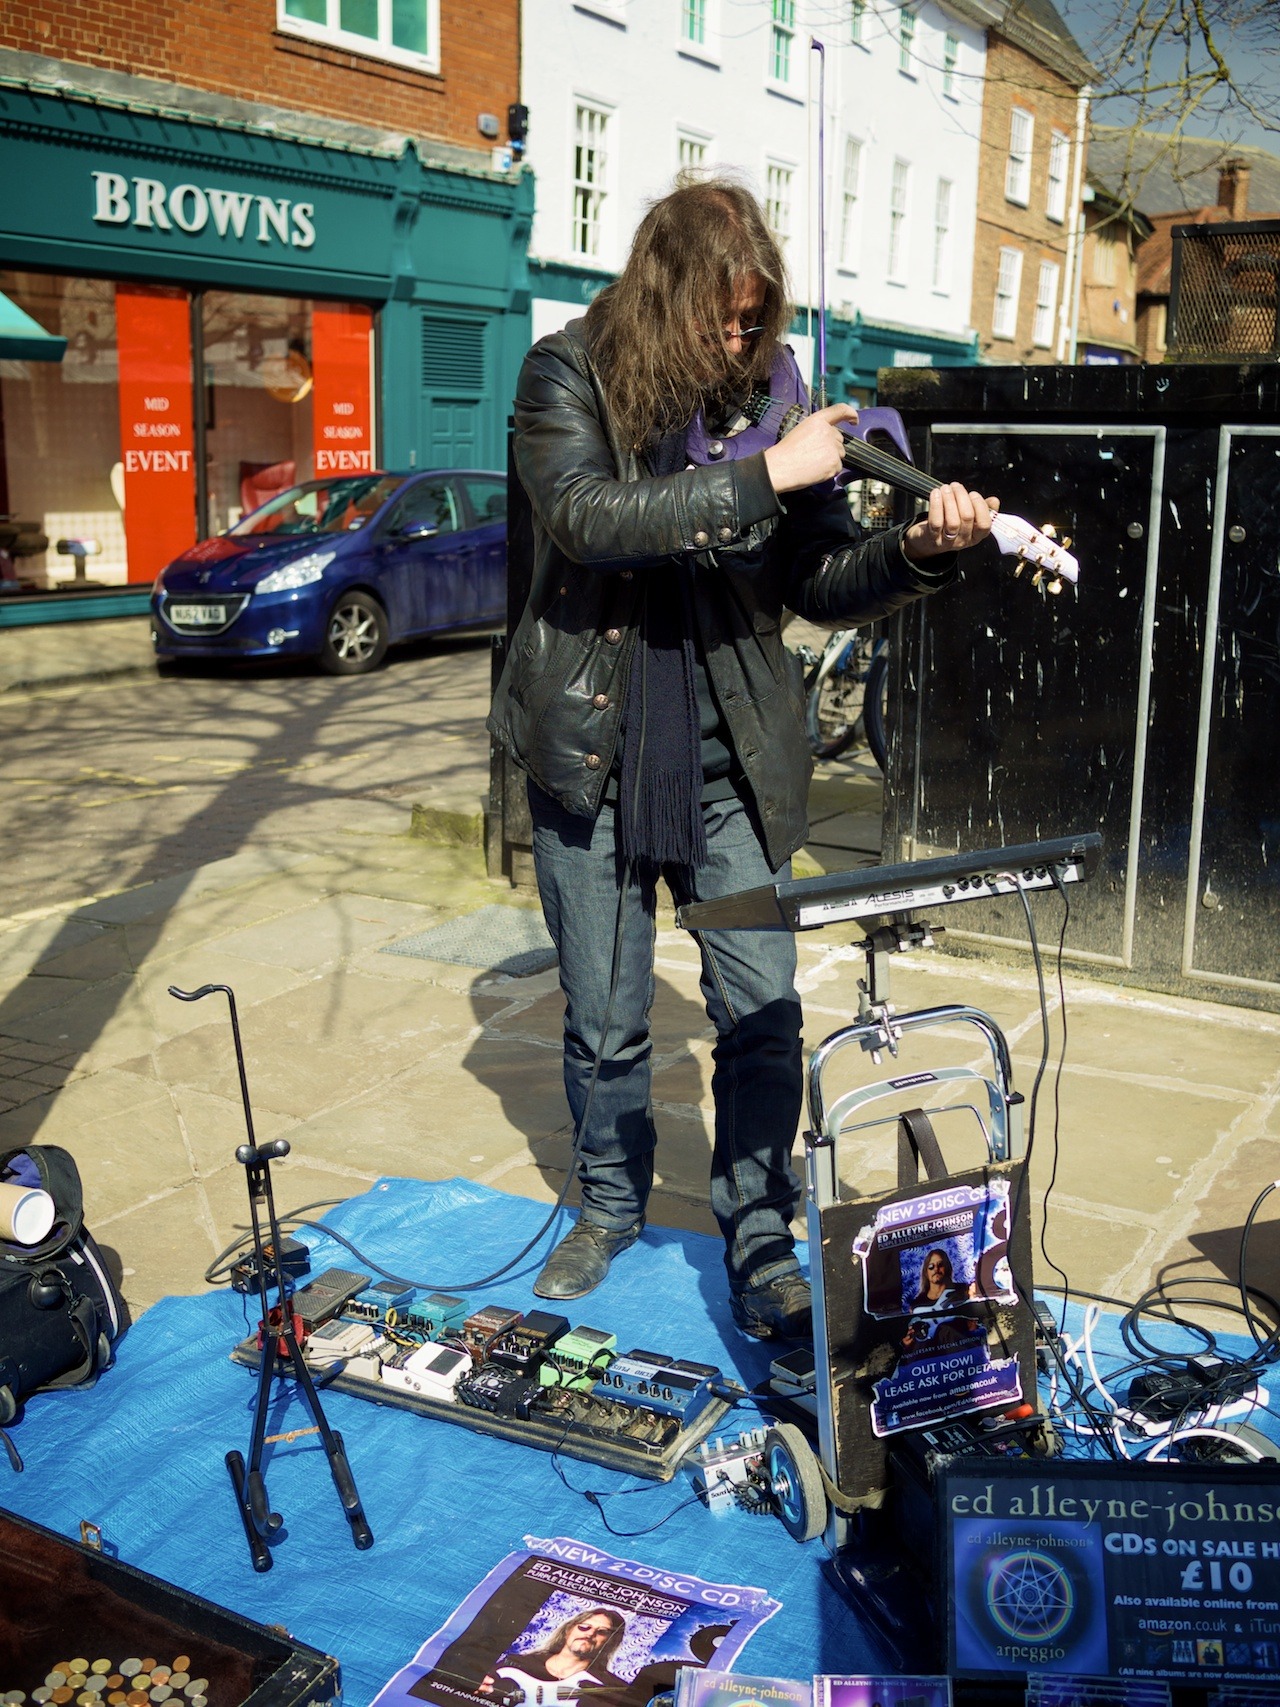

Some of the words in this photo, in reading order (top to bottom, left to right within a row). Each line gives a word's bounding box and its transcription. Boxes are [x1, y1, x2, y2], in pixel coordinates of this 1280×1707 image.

[91, 170, 316, 247] BROWNS
[144, 397, 170, 411] MID
[333, 403, 354, 415] MID
[133, 423, 181, 437] SEASON
[323, 426, 363, 439] SEASON
[125, 450, 192, 472] EVENT
[316, 450, 371, 470] EVENT
[865, 888, 914, 905] ALESIS
[880, 1205, 913, 1225] NEW
[917, 1193, 965, 1215] 2-DISC
[877, 1235, 888, 1243] ED
[891, 1212, 973, 1240] ALLEYNE-JOHNSON
[937, 1341, 958, 1350] SPECIAL
[911, 1363, 936, 1377] OUT
[941, 1355, 974, 1372] NOW!
[918, 1377, 940, 1389] ASK
[943, 1370, 965, 1383] FOR
[933, 1392, 948, 1400] from
[952, 1484, 995, 1515] ed
[1009, 1486, 1280, 1533] alleyne-johns
[967, 1531, 982, 1544] ed
[1162, 1539, 1198, 1557] ON
[1203, 1540, 1256, 1558] SALE
[548, 1541, 607, 1565] NEW
[607, 1561, 697, 1594] 2-DISC
[701, 1588, 741, 1606] CD
[1180, 1561, 1254, 1592] £10
[526, 1570, 557, 1582] PURPLE
[558, 1578, 596, 1595] ELECTRIC
[599, 1590, 629, 1603] VIOLIN
[630, 1599, 681, 1617] CONCERTO
[532, 1562, 552, 1573] ED
[552, 1568, 687, 1614] ALLEYNE-JOHNSON
[1113, 1595, 1142, 1606] Also
[1145, 1596, 1200, 1608] available
[1203, 1598, 1243, 1610] online
[1246, 1599, 1279, 1610] from
[1138, 1618, 1228, 1631] amazon.co.uk
[1234, 1623, 1243, 1633] &
[996, 1642, 1065, 1663] arpeggio
[1118, 1666, 1135, 1676] (All
[1136, 1668, 1154, 1677] nine
[1156, 1668, 1186, 1678] albums
[1203, 1671, 1222, 1679] now
[430, 1681, 454, 1694] 20TH
[703, 1679, 717, 1689] ed
[719, 1681, 803, 1700] alleyne-johnson
